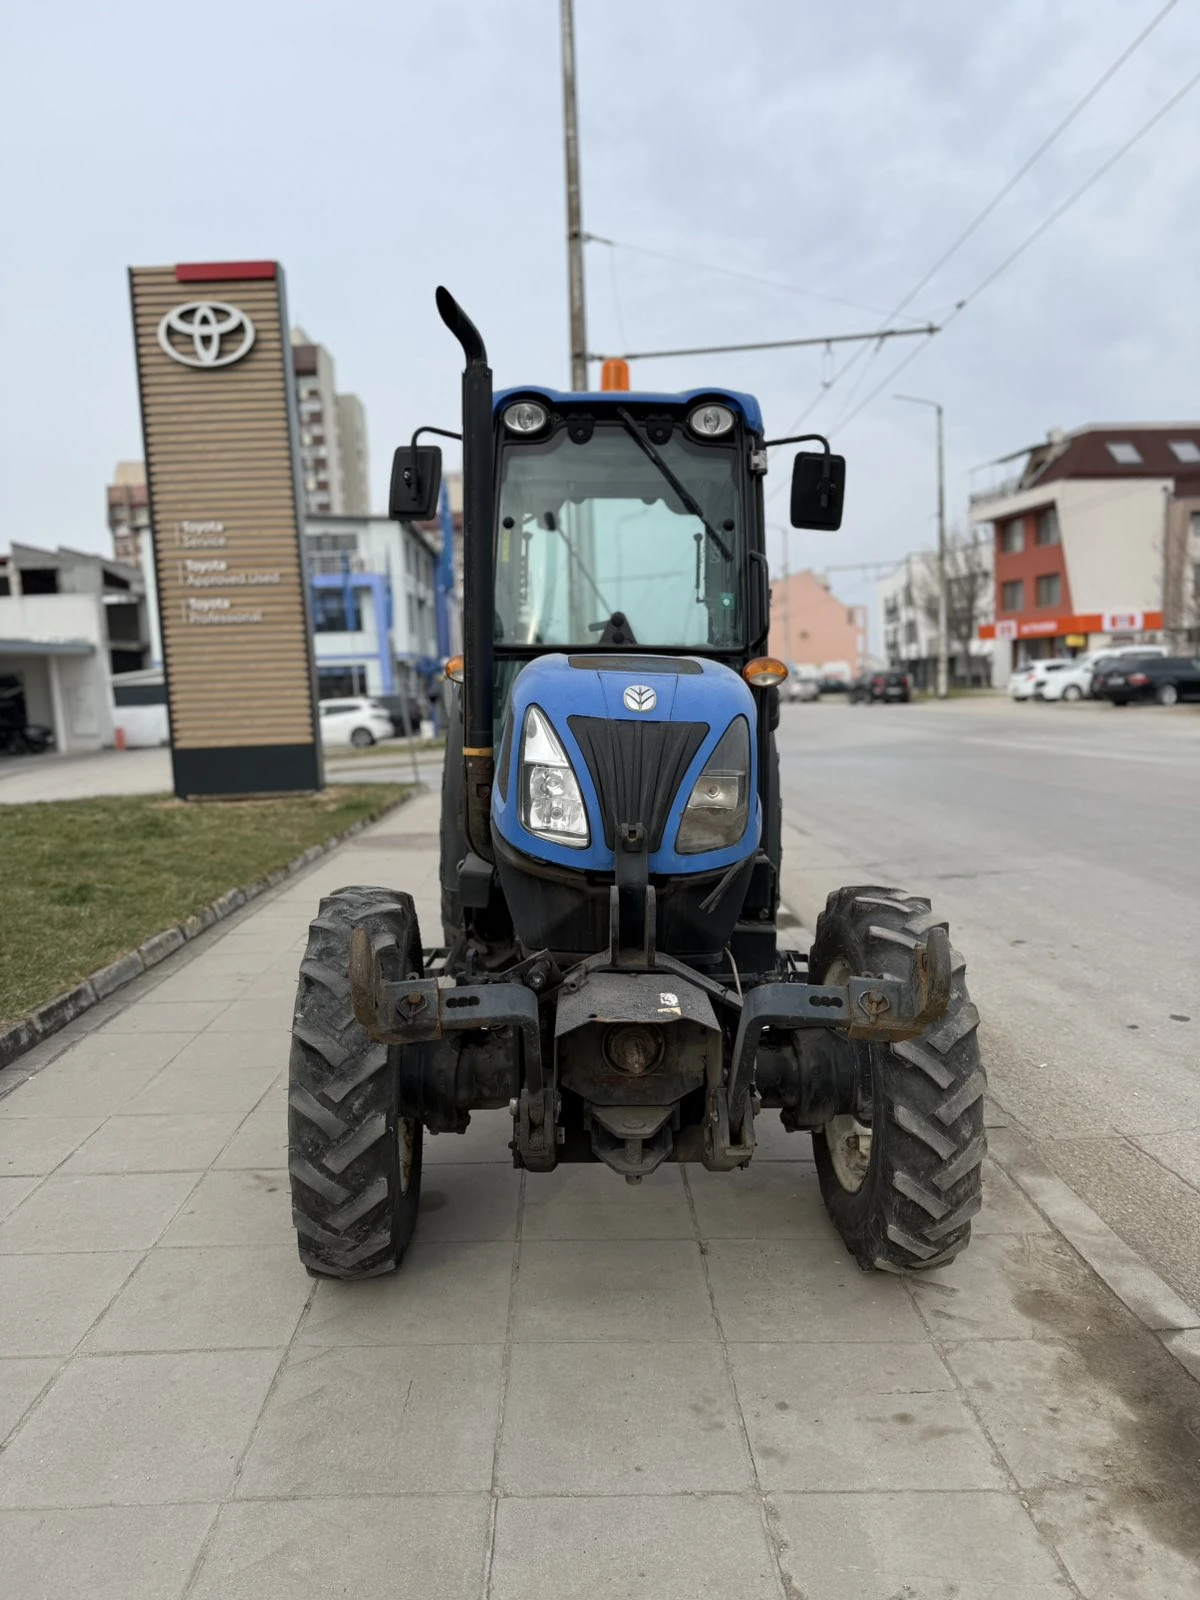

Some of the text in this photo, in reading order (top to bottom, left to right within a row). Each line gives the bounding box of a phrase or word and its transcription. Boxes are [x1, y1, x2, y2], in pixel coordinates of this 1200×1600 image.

[182, 521, 224, 535] Toyota
[185, 559, 227, 573] Toyota
[189, 598, 231, 612] Toyota
